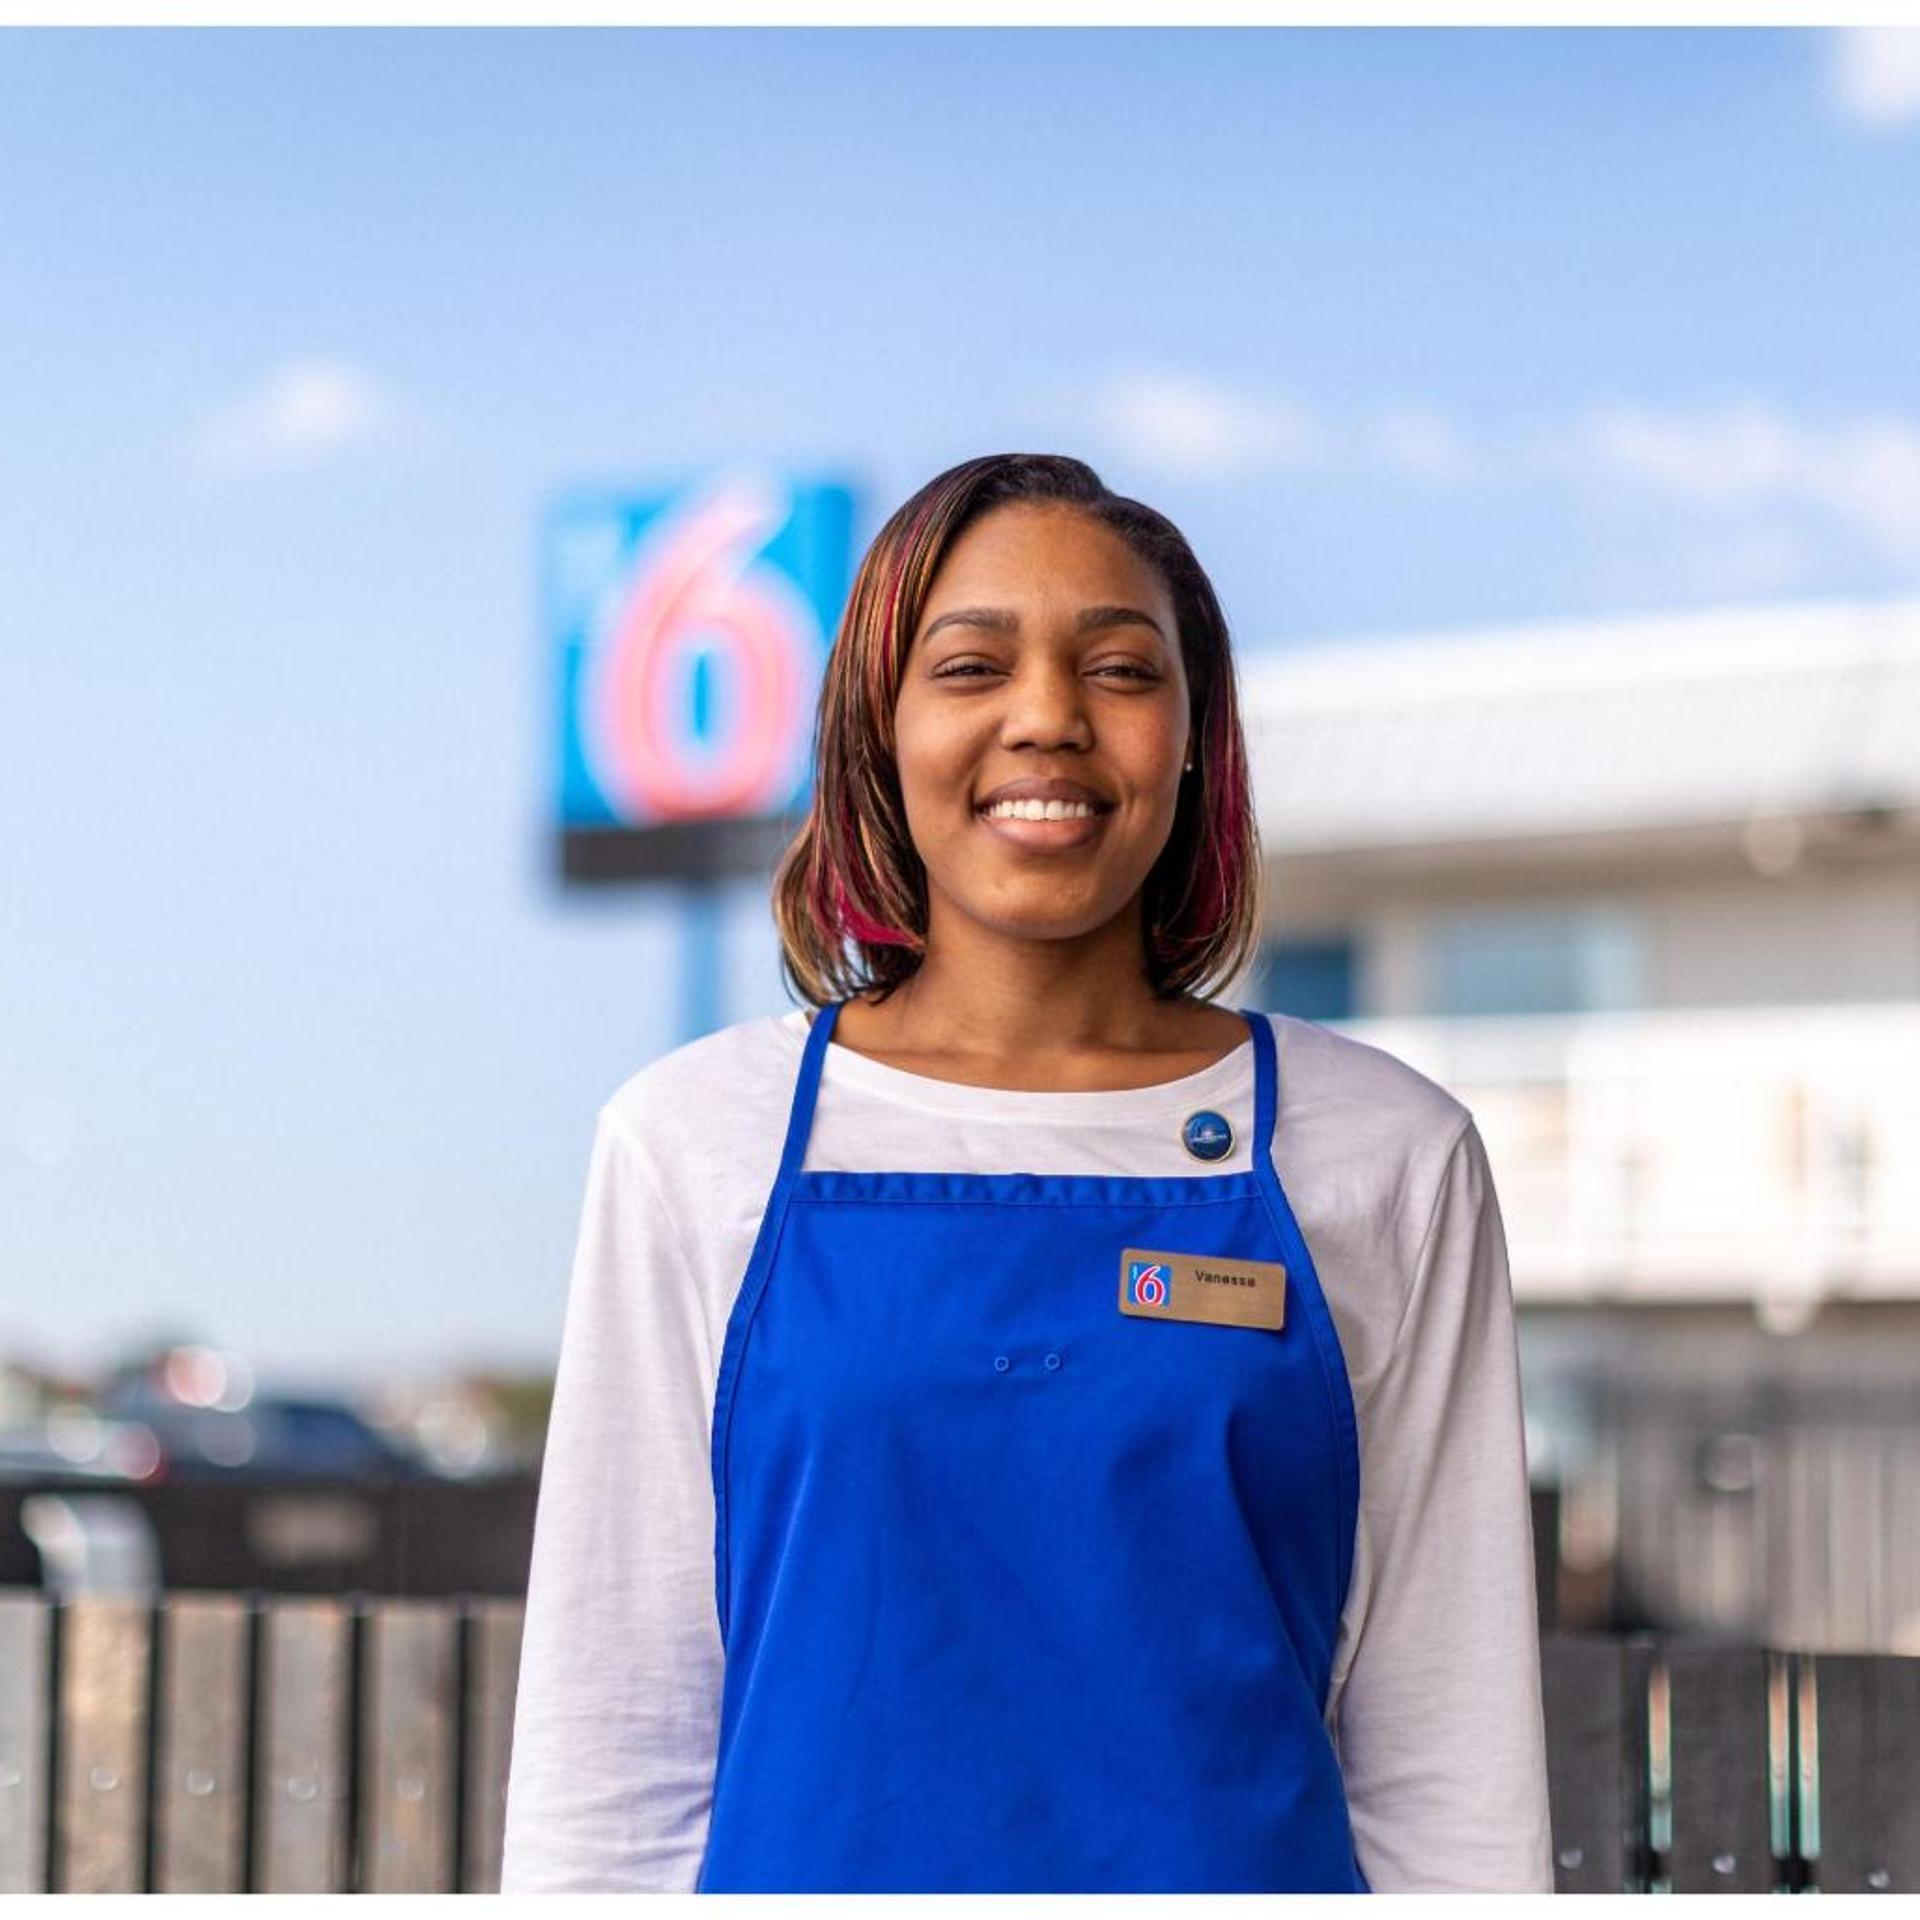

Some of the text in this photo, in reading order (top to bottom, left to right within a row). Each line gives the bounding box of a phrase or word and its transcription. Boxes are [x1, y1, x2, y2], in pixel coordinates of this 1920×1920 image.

[583, 476, 818, 822] 6
[1135, 1265, 1166, 1306] 6
[1195, 1269, 1256, 1287] Vanessa
